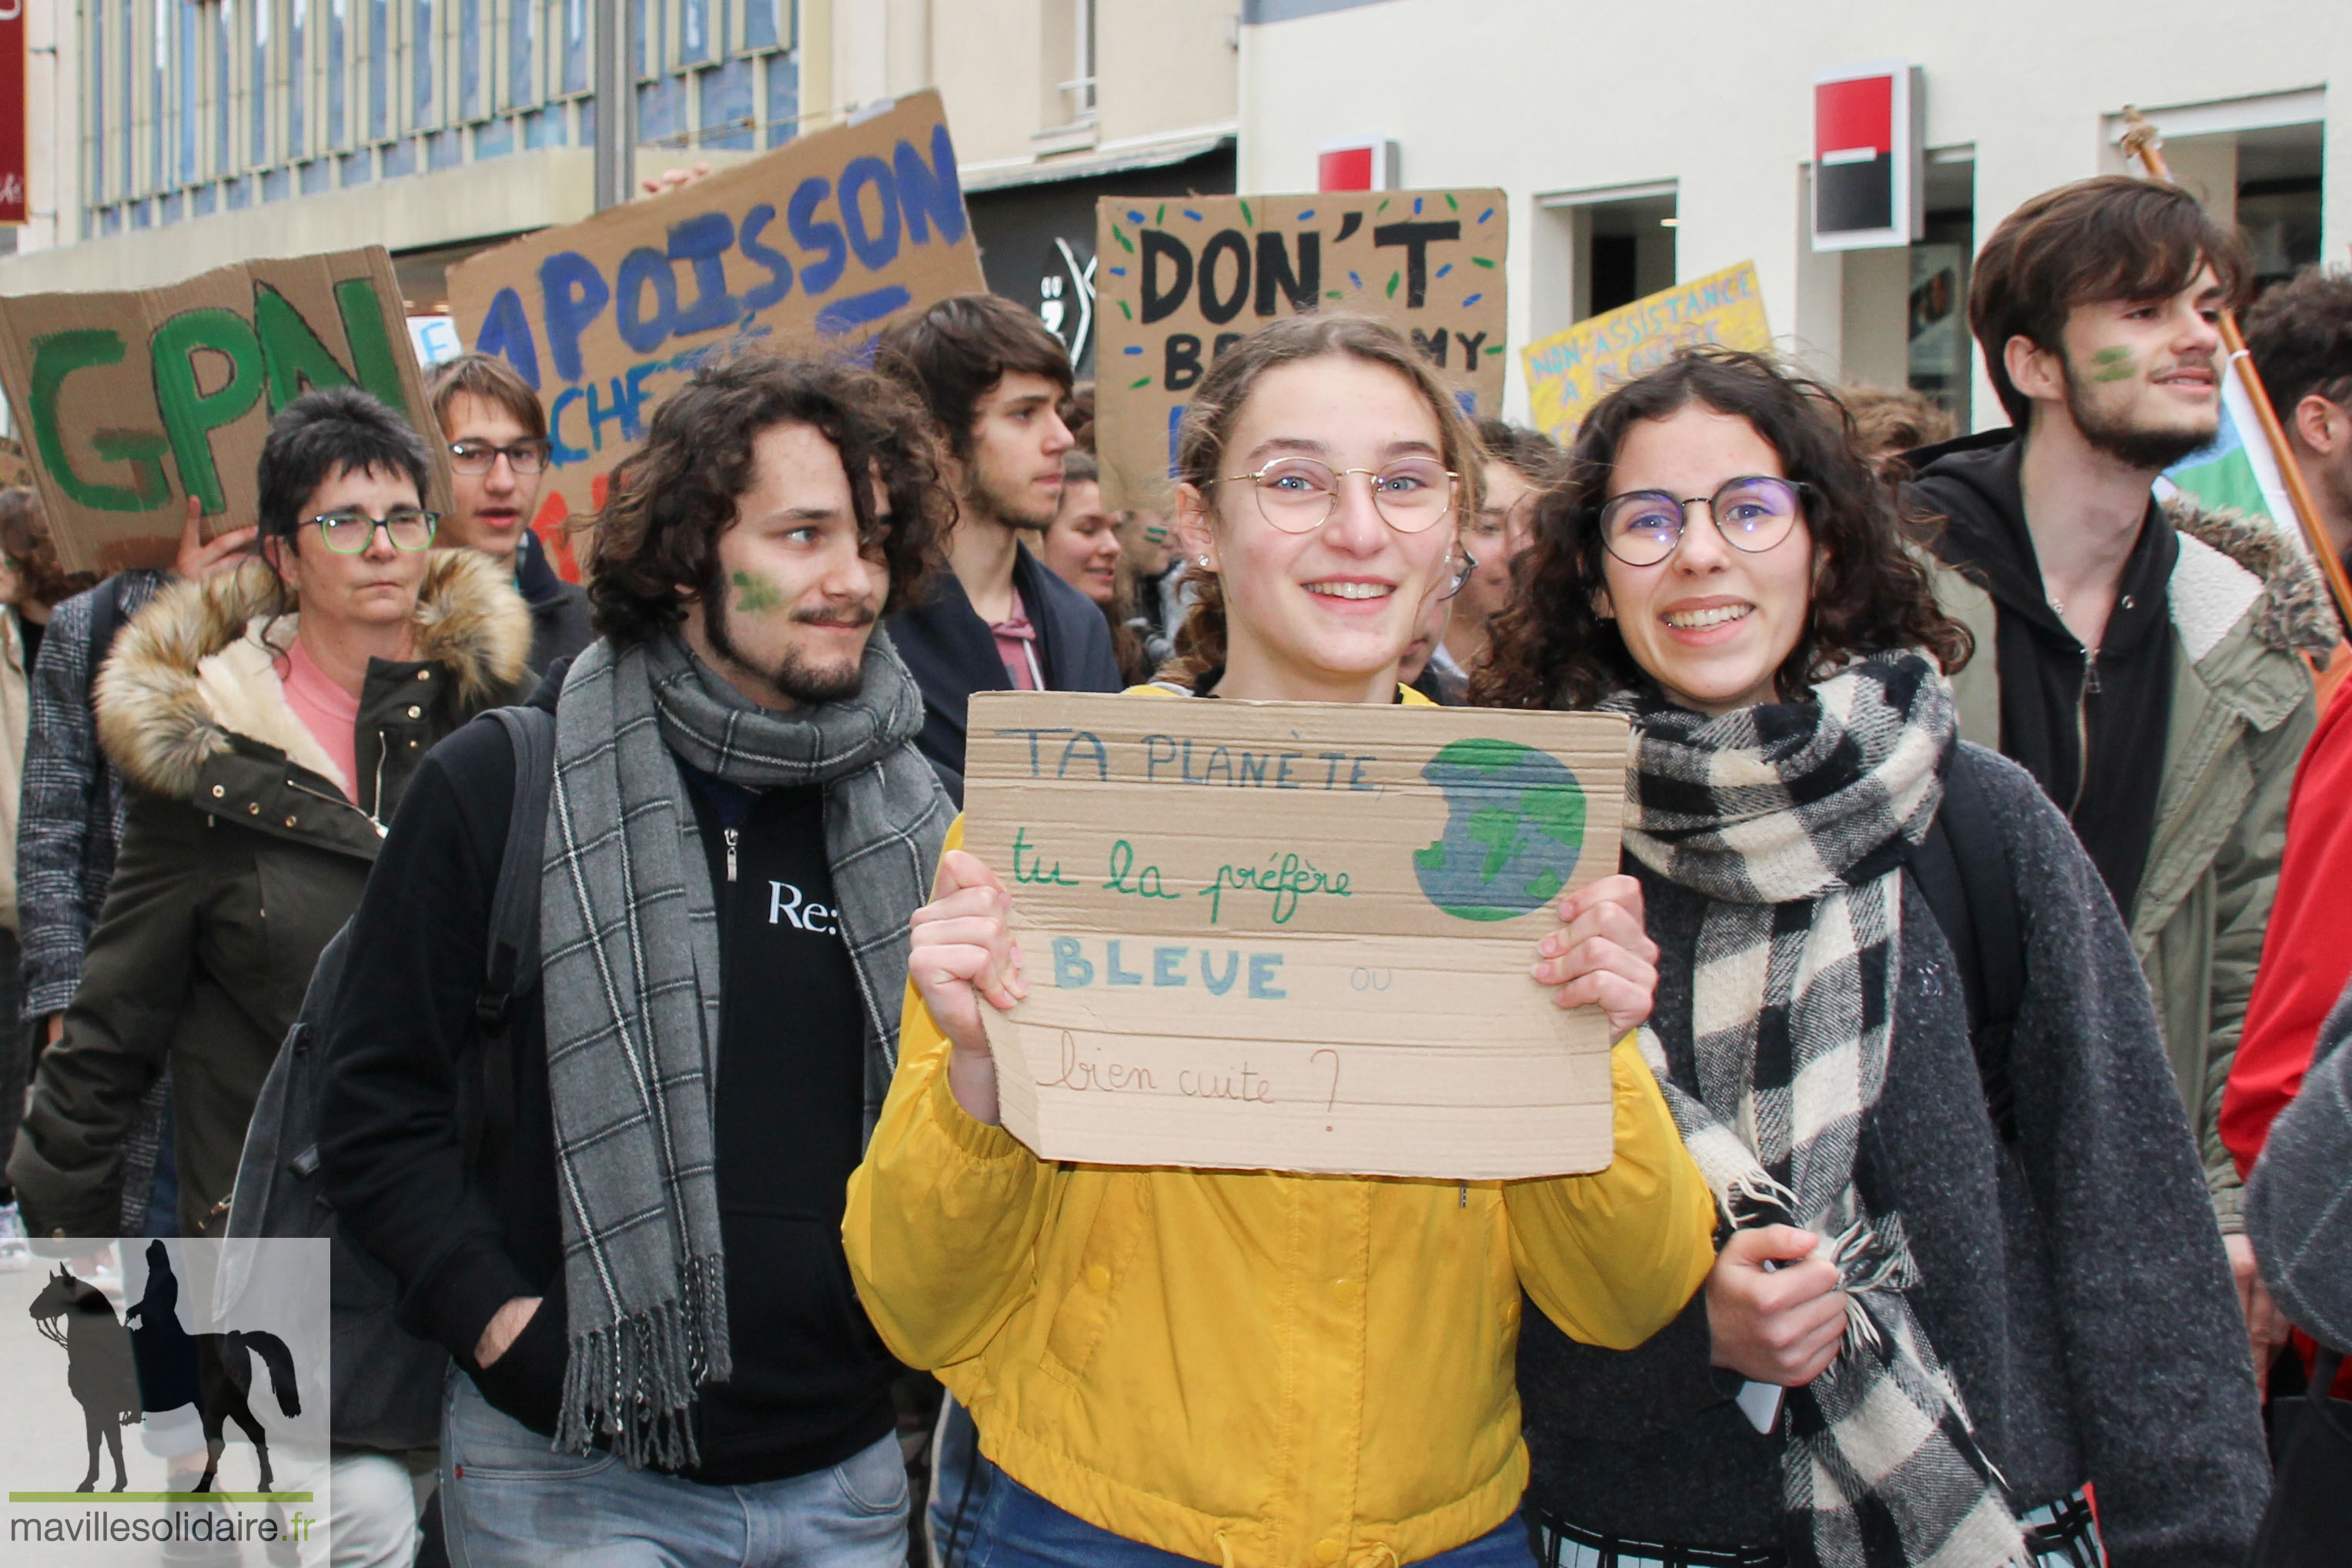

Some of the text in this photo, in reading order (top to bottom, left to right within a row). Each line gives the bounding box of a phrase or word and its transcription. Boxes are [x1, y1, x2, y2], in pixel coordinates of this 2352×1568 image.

[540, 123, 966, 382] POISSON
[1139, 212, 1460, 326] DON'T
[994, 727, 1385, 801] TA PLANÈTE,
[1012, 827, 1353, 924] tu la préfère
[1052, 937, 1287, 1000] BLEUE
[1035, 1030, 1340, 1132] bien cuite ?
